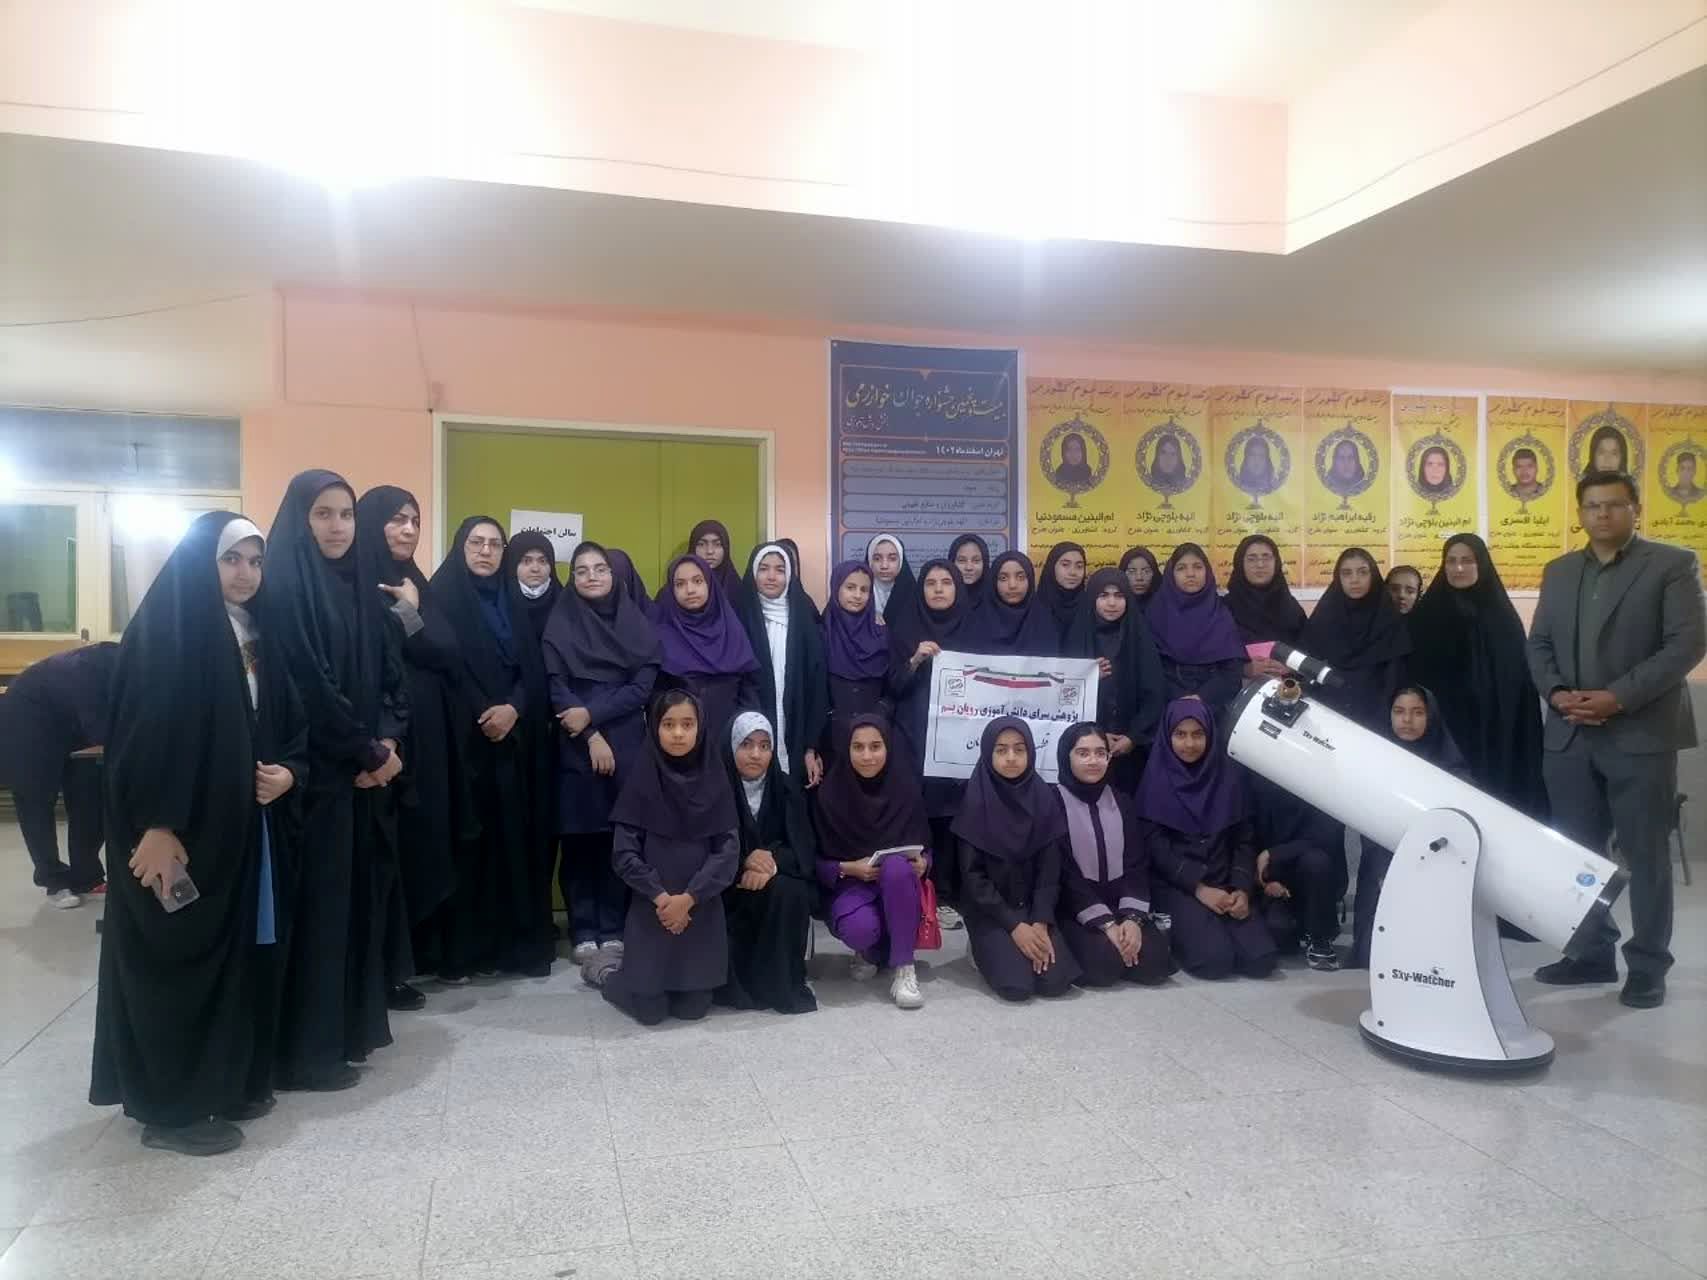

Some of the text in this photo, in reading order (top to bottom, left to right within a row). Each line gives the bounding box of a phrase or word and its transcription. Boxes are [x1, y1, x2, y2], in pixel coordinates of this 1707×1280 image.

[846, 383, 890, 409] خوارزمی
[984, 446, 1004, 460] تهران
[1036, 512, 1114, 524] ام البنین مسعودنیا
[1136, 512, 1152, 523] نژاد
[1153, 512, 1179, 524] بلوچی
[1358, 512, 1376, 523] رقیه
[1416, 518, 1439, 528] بلوچی
[1439, 517, 1461, 529] البنین
[1462, 517, 1472, 528] ام
[558, 527, 577, 538] سالن
[956, 702, 978, 717] رویان
[980, 704, 1005, 717] آموزی
[1006, 705, 1028, 718] دانش
[1028, 707, 1050, 720] سرای
[1050, 709, 1079, 723] پژوهش
[1392, 968, 1456, 989] Sky-Watcher
